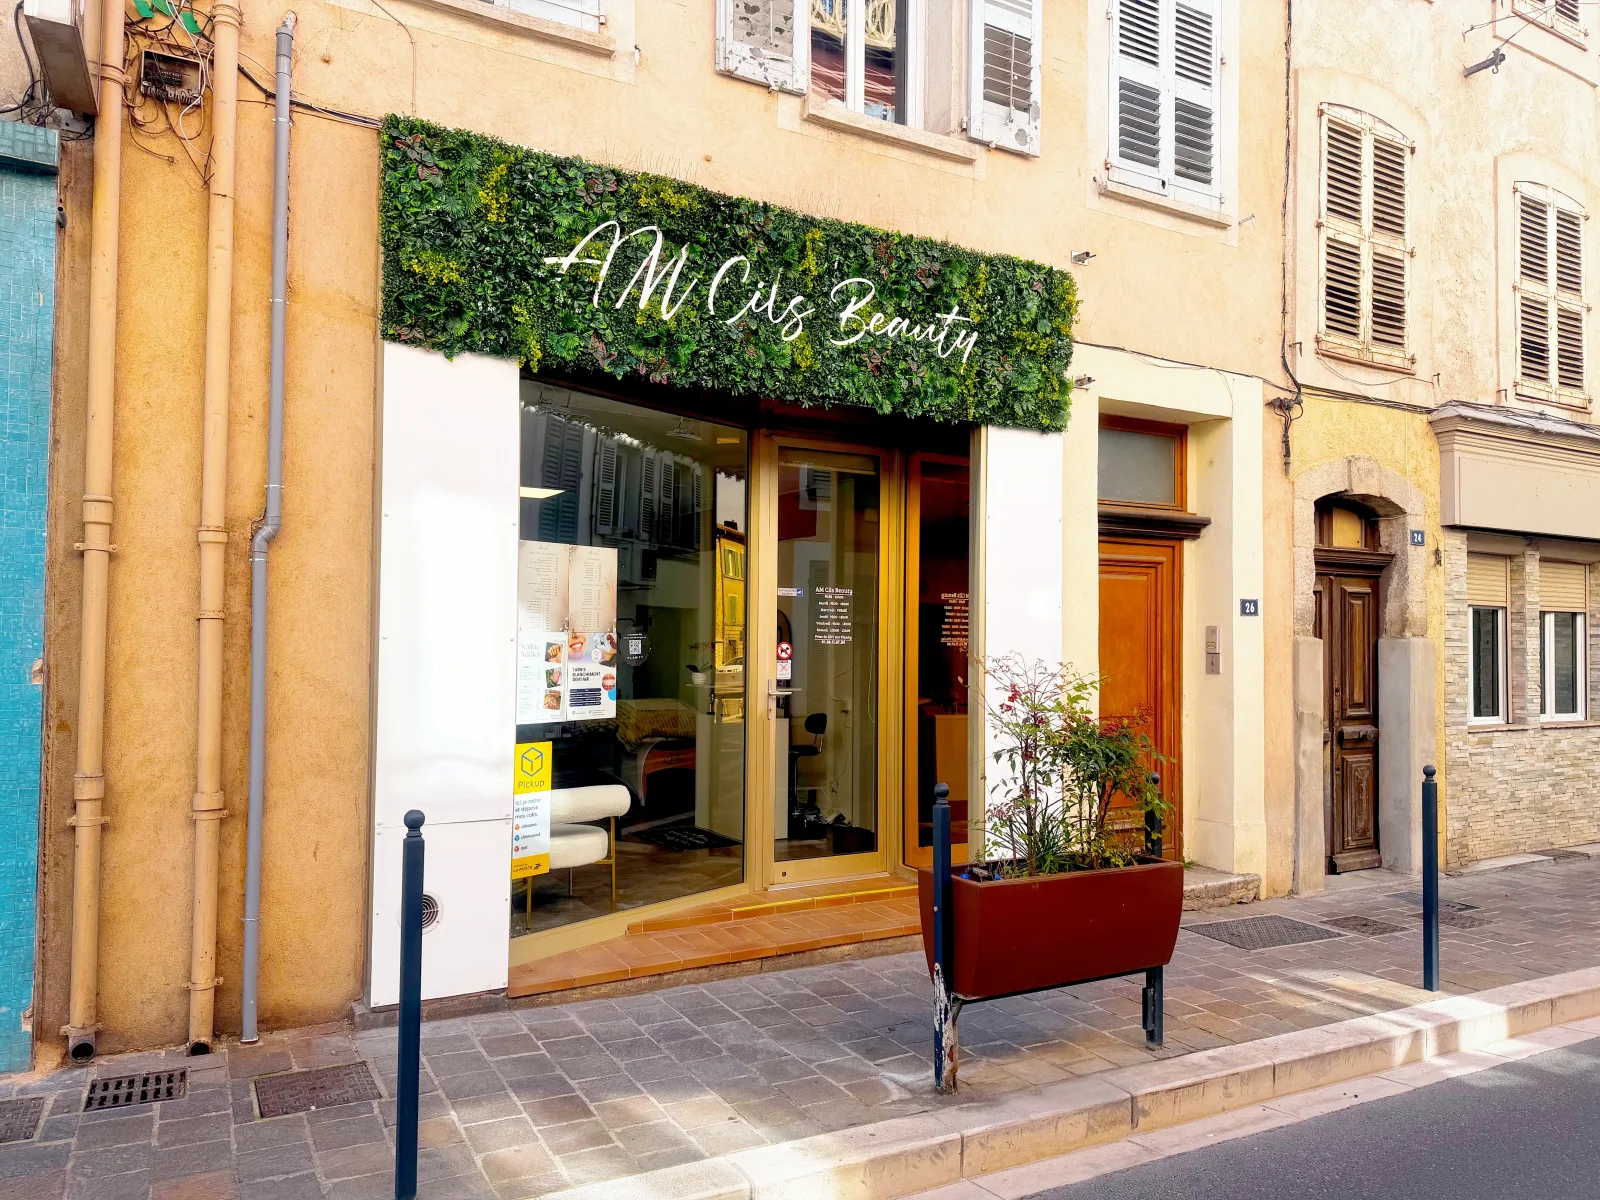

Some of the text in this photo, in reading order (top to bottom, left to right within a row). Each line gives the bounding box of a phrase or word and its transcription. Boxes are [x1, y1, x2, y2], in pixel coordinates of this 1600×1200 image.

[544, 221, 979, 375] AM Cils Beauty
[1413, 532, 1422, 543] 24
[836, 587, 853, 596] Beauty
[1245, 602, 1255, 613] 26
[518, 780, 545, 789] Pickup
